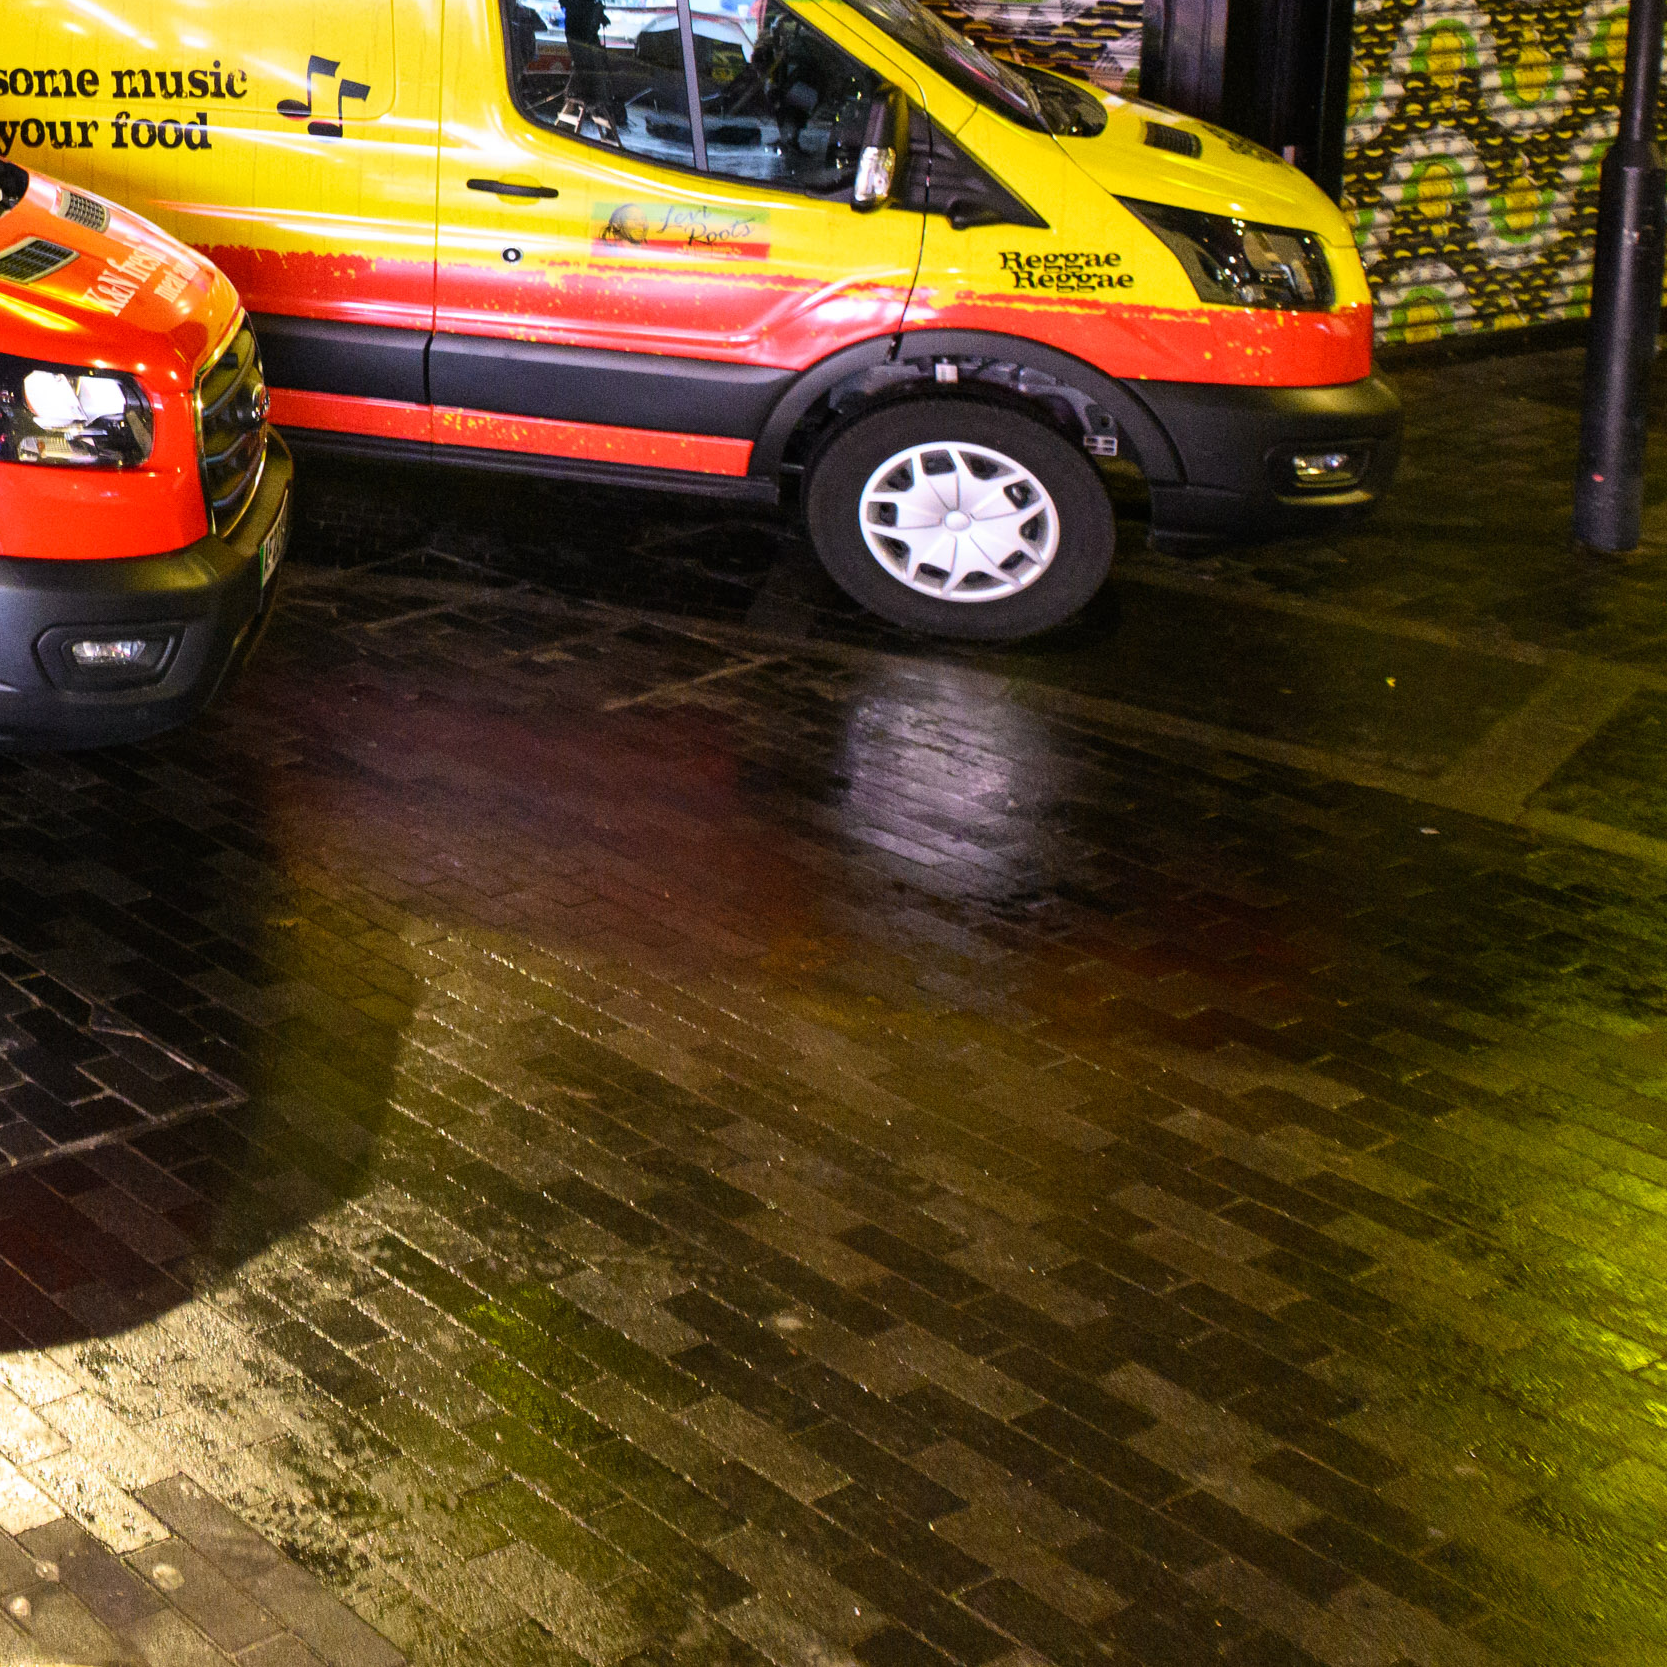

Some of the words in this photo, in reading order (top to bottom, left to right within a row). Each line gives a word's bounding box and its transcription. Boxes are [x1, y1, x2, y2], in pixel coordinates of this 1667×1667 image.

[111, 60, 248, 100] music
[113, 111, 213, 152] food
[998, 251, 1122, 273] Reggae
[1011, 270, 1135, 293] Reggae
